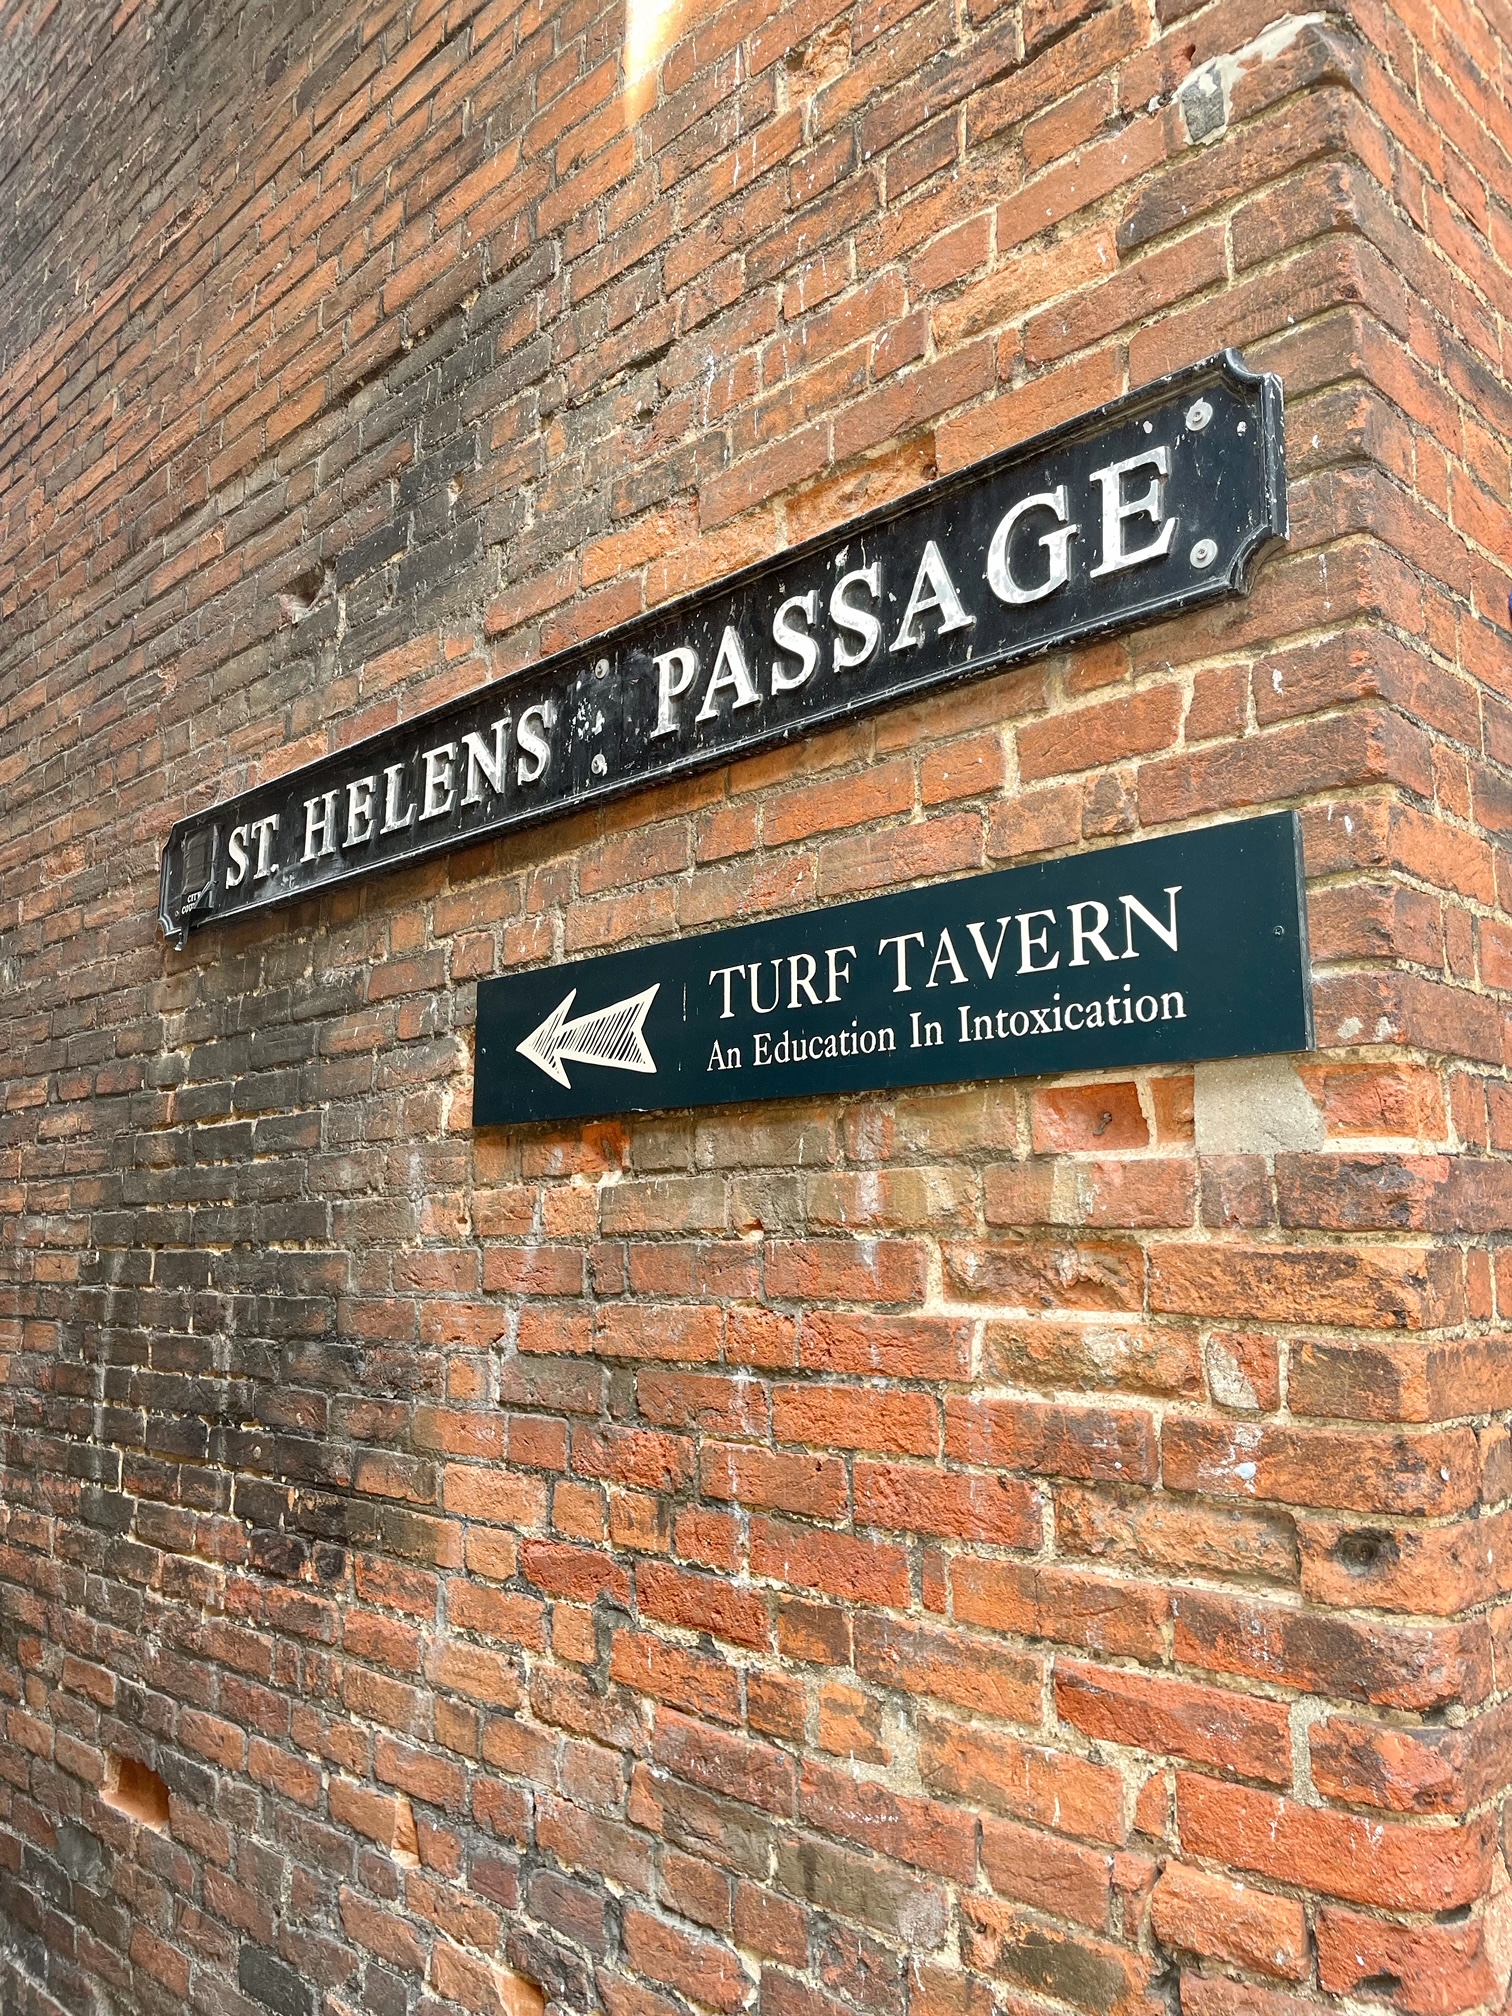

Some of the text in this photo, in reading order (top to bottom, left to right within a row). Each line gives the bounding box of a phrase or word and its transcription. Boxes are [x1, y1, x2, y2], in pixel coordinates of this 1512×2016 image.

[226, 444, 1179, 890] ST. HELENS PASSAGE
[709, 885, 1184, 1020] TURF TAVERN
[706, 983, 1188, 1073] An Education In Intoxication
